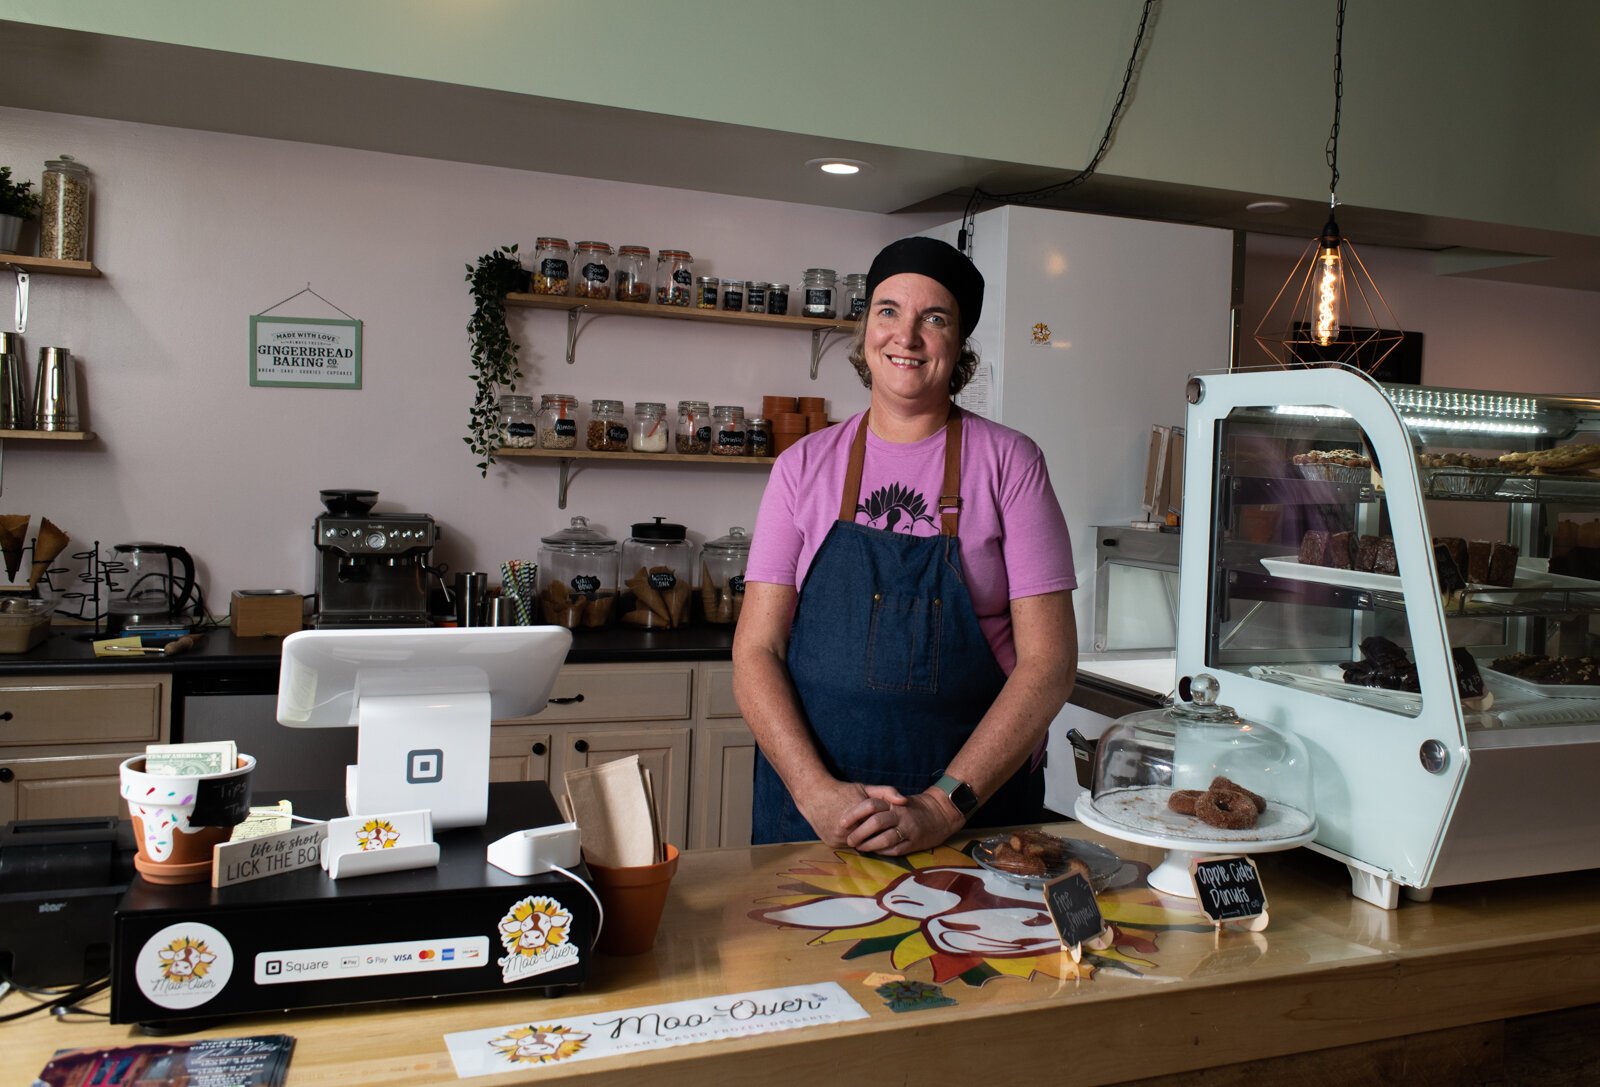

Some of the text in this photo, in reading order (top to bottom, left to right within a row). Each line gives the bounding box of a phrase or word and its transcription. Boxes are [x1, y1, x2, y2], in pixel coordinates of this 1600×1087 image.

[546, 259, 563, 268] Sour
[276, 332, 296, 340] MADE
[318, 334, 336, 342] LOVE
[257, 344, 353, 359] GINGERBREAD
[273, 356, 324, 368] BAKING
[250, 831, 320, 858] life is short
[227, 845, 321, 881] LICK THE BO
[1229, 861, 1256, 883] Cider
[1053, 891, 1073, 912] Free
[1209, 886, 1250, 909] Donuts
[375, 955, 388, 964] Pay
[393, 953, 413, 962] VISA
[285, 960, 329, 973] Square
[664, 1031, 708, 1041] BASED
[713, 1023, 764, 1034] FROZEN
[770, 1014, 832, 1026] DESSERTS
